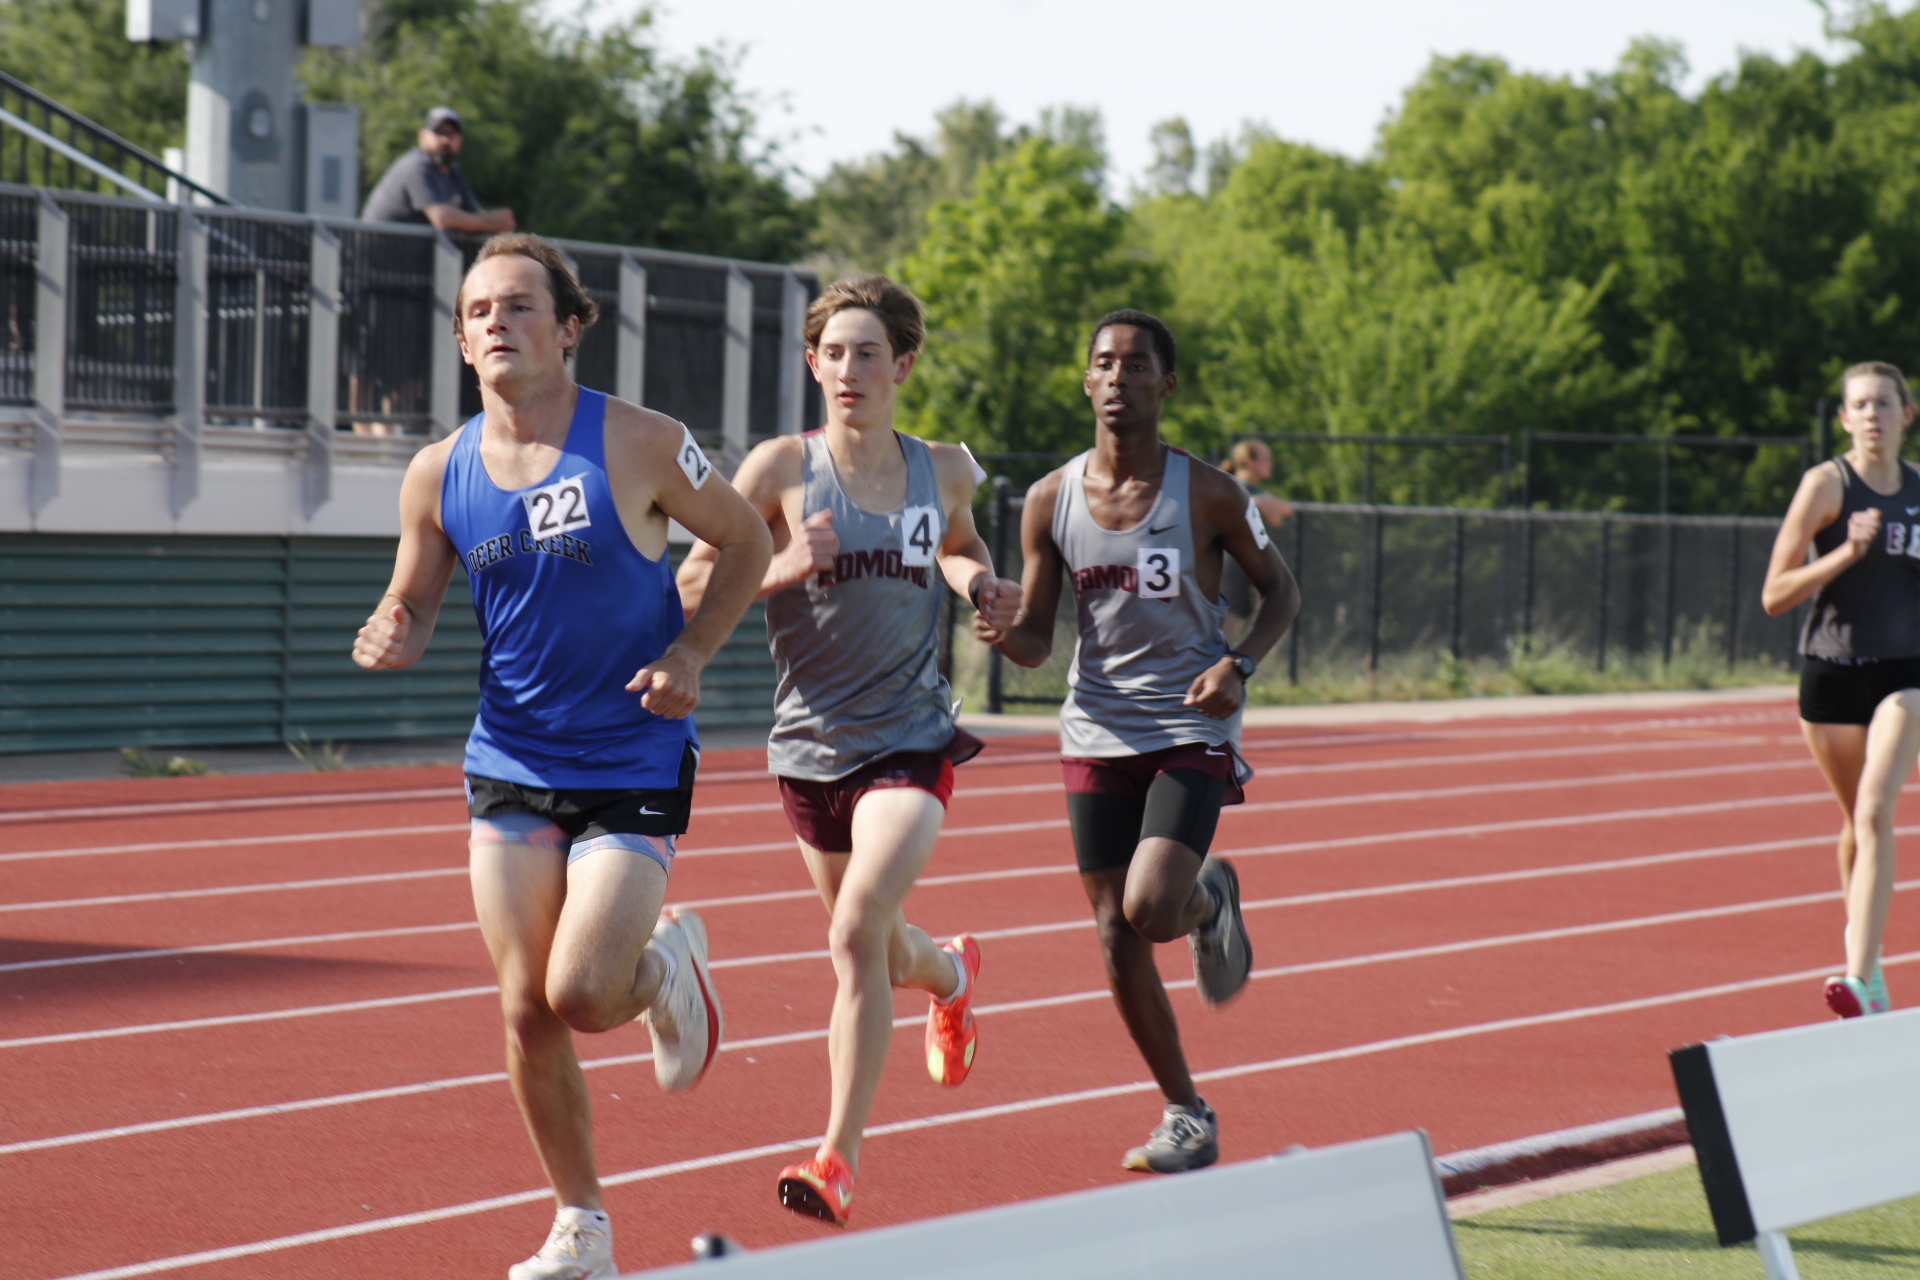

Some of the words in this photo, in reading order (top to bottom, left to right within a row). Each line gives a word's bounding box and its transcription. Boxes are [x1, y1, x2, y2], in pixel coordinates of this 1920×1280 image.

[532, 485, 586, 531] 22
[467, 533, 515, 575] DEER
[909, 513, 933, 555] 4
[1146, 553, 1171, 591] 3
